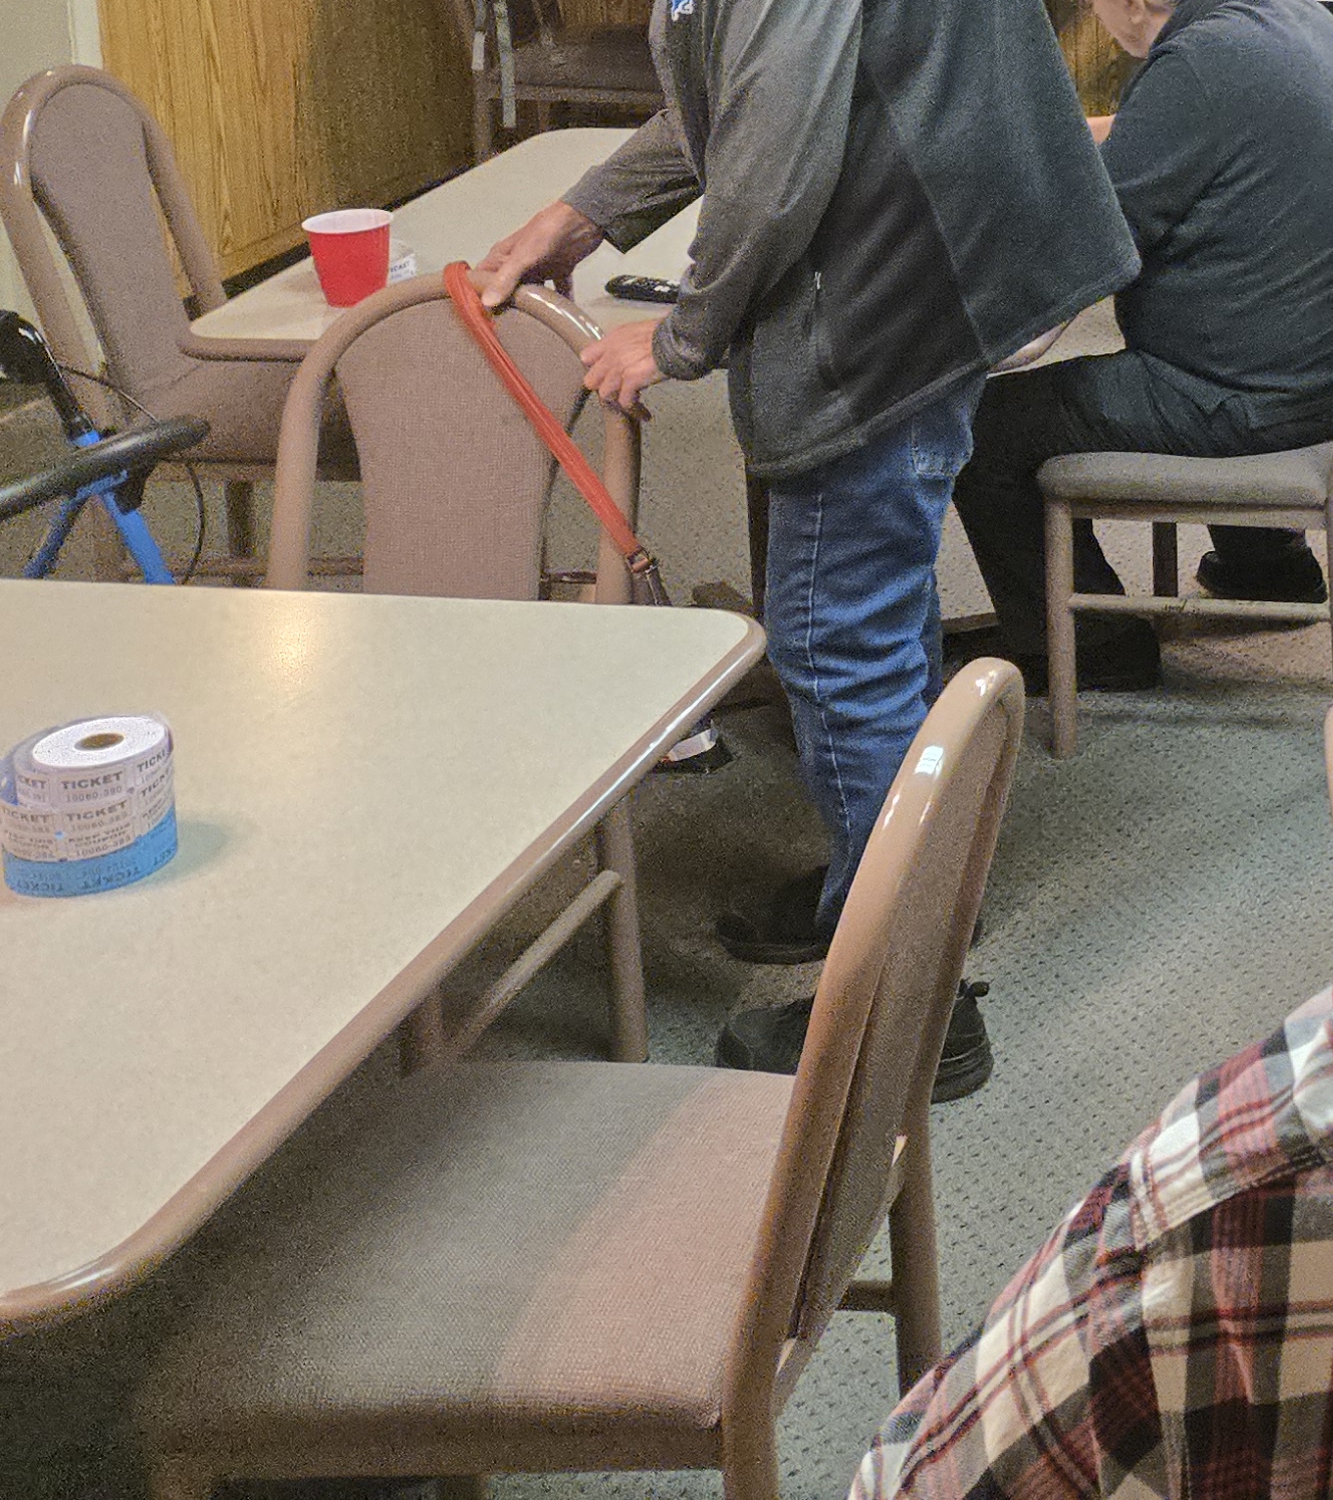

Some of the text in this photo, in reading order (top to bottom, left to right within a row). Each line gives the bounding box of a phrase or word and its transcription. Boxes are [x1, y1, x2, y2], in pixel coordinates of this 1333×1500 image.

[137, 749, 166, 773] TICK
[61, 771, 123, 790] TICKET
[66, 800, 128, 822] TICKET
